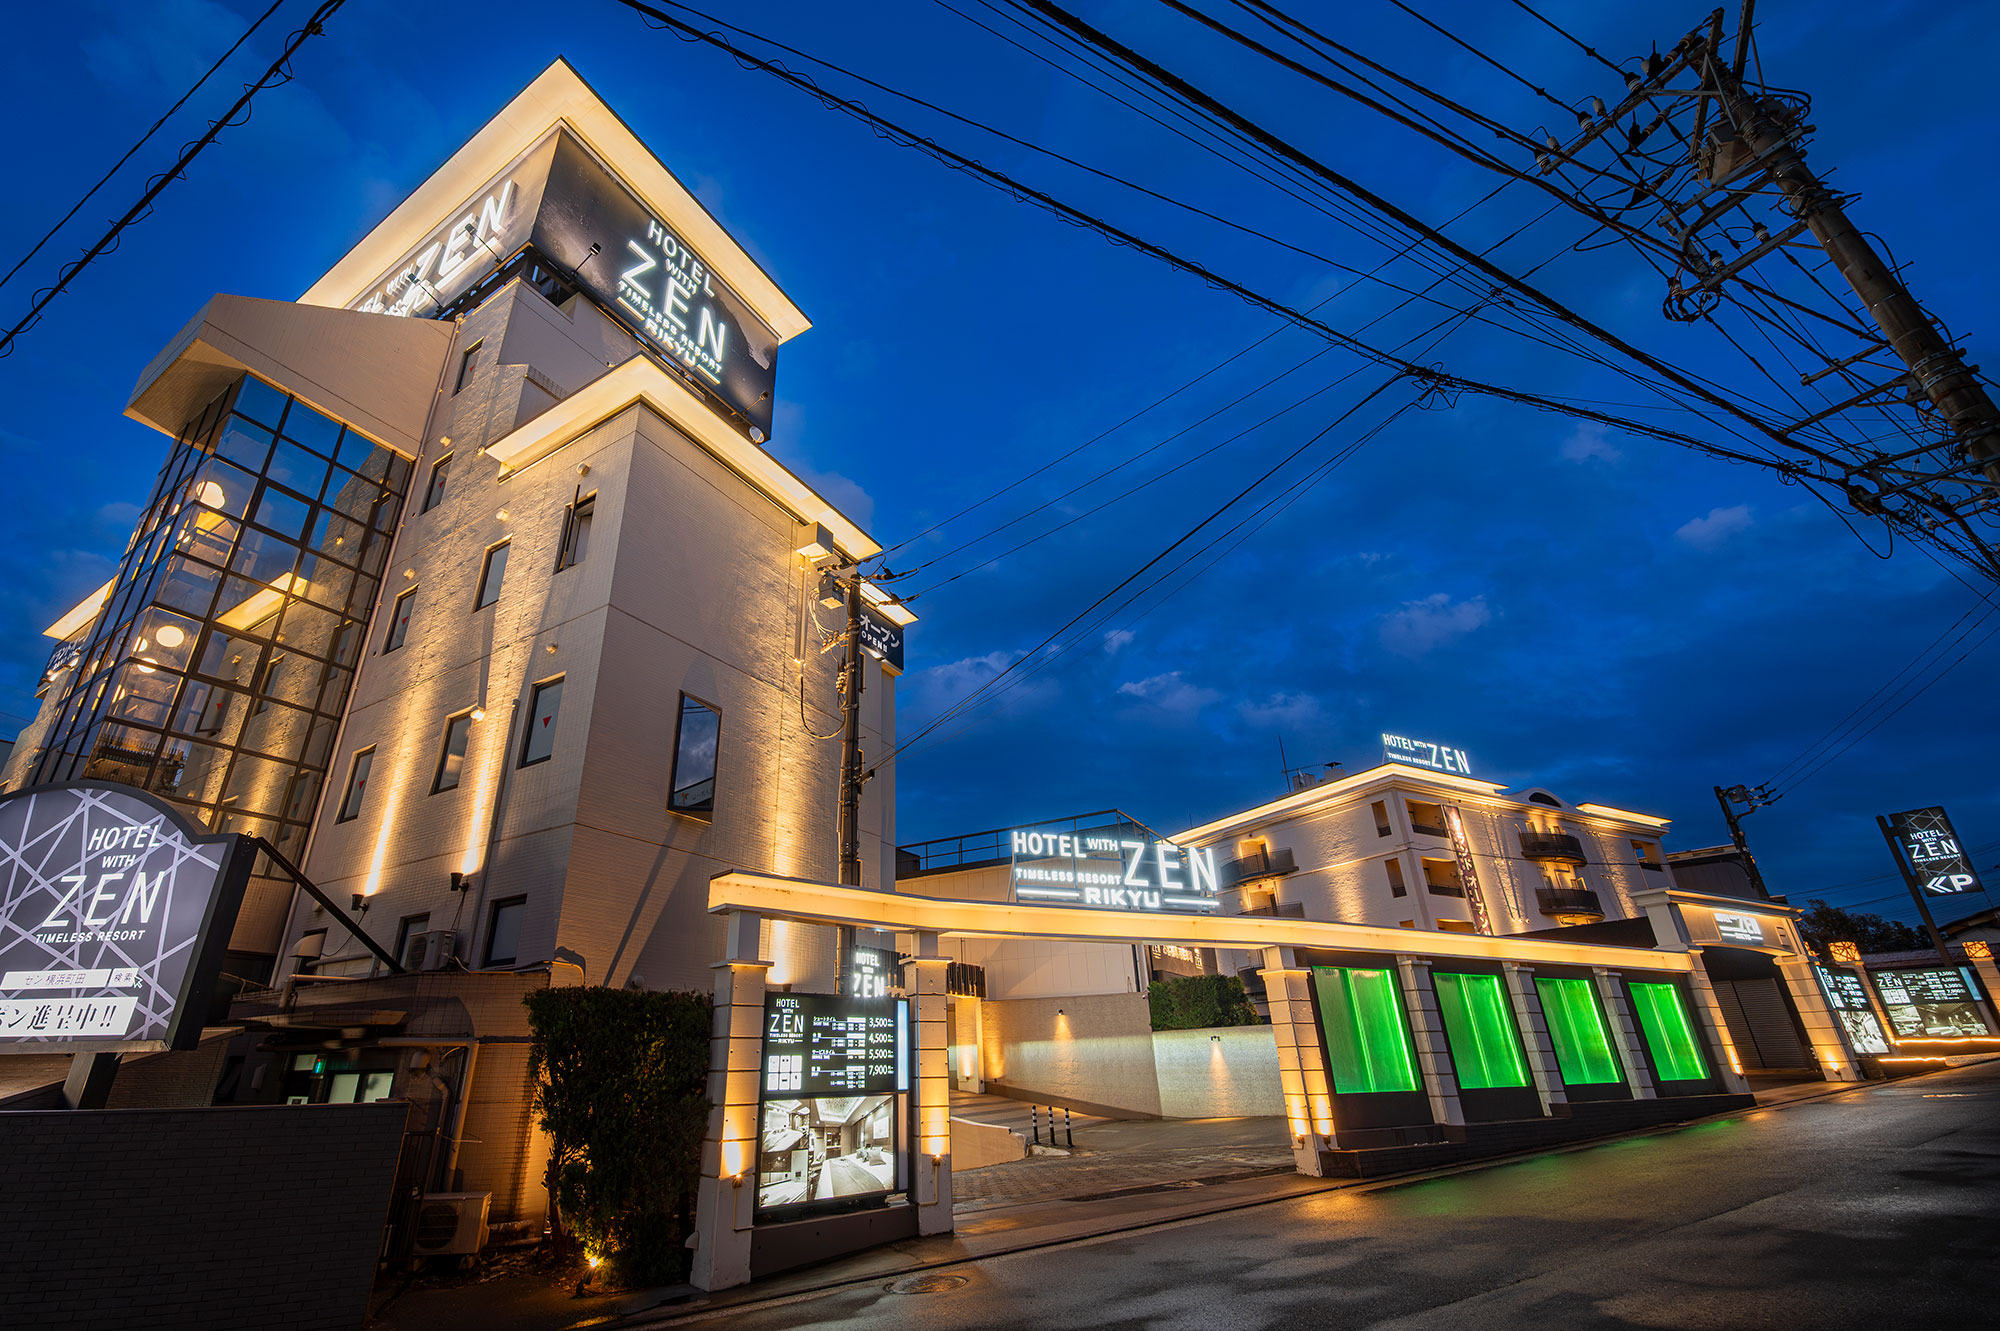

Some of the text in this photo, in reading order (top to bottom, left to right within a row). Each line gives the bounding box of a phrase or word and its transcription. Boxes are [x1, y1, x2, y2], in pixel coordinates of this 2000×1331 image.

[402, 179, 519, 306] ZEN
[647, 219, 716, 299] HOTEL
[664, 258, 698, 295] WITH
[620, 239, 726, 363] ZEN
[616, 280, 723, 374] TIMELESS RESORT
[644, 318, 697, 367] RIKYU
[859, 613, 900, 648] オープン
[1382, 733, 1415, 751] HOTEL
[1427, 742, 1471, 775] ZEN
[87, 824, 163, 851] HOTEL
[1910, 829, 1944, 841] HOTEL
[1908, 839, 1959, 859] ZEN
[101, 854, 136, 869] WITH
[1012, 830, 1219, 892] HOTEL WITH ZEN
[1015, 868, 1122, 886] TIMELESS RESORT
[1949, 873, 1974, 892] P
[41, 871, 166, 928] ZEN
[1084, 886, 1160, 908] RIKYU
[35, 930, 146, 945] TIMELESS RESORT
[855, 951, 880, 967] HOTEL
[45, 972, 87, 986] 横浜町田
[853, 973, 885, 998] ZEN
[1876, 977, 1904, 988] ZEN
[776, 998, 800, 1009] HOTEL
[769, 1013, 805, 1033] ZEN
[868, 1017, 888, 1028] 3,500
[868, 1034, 888, 1044] 4,500
[868, 1049, 888, 1060] 5,500
[868, 1065, 888, 1076] 7,900
